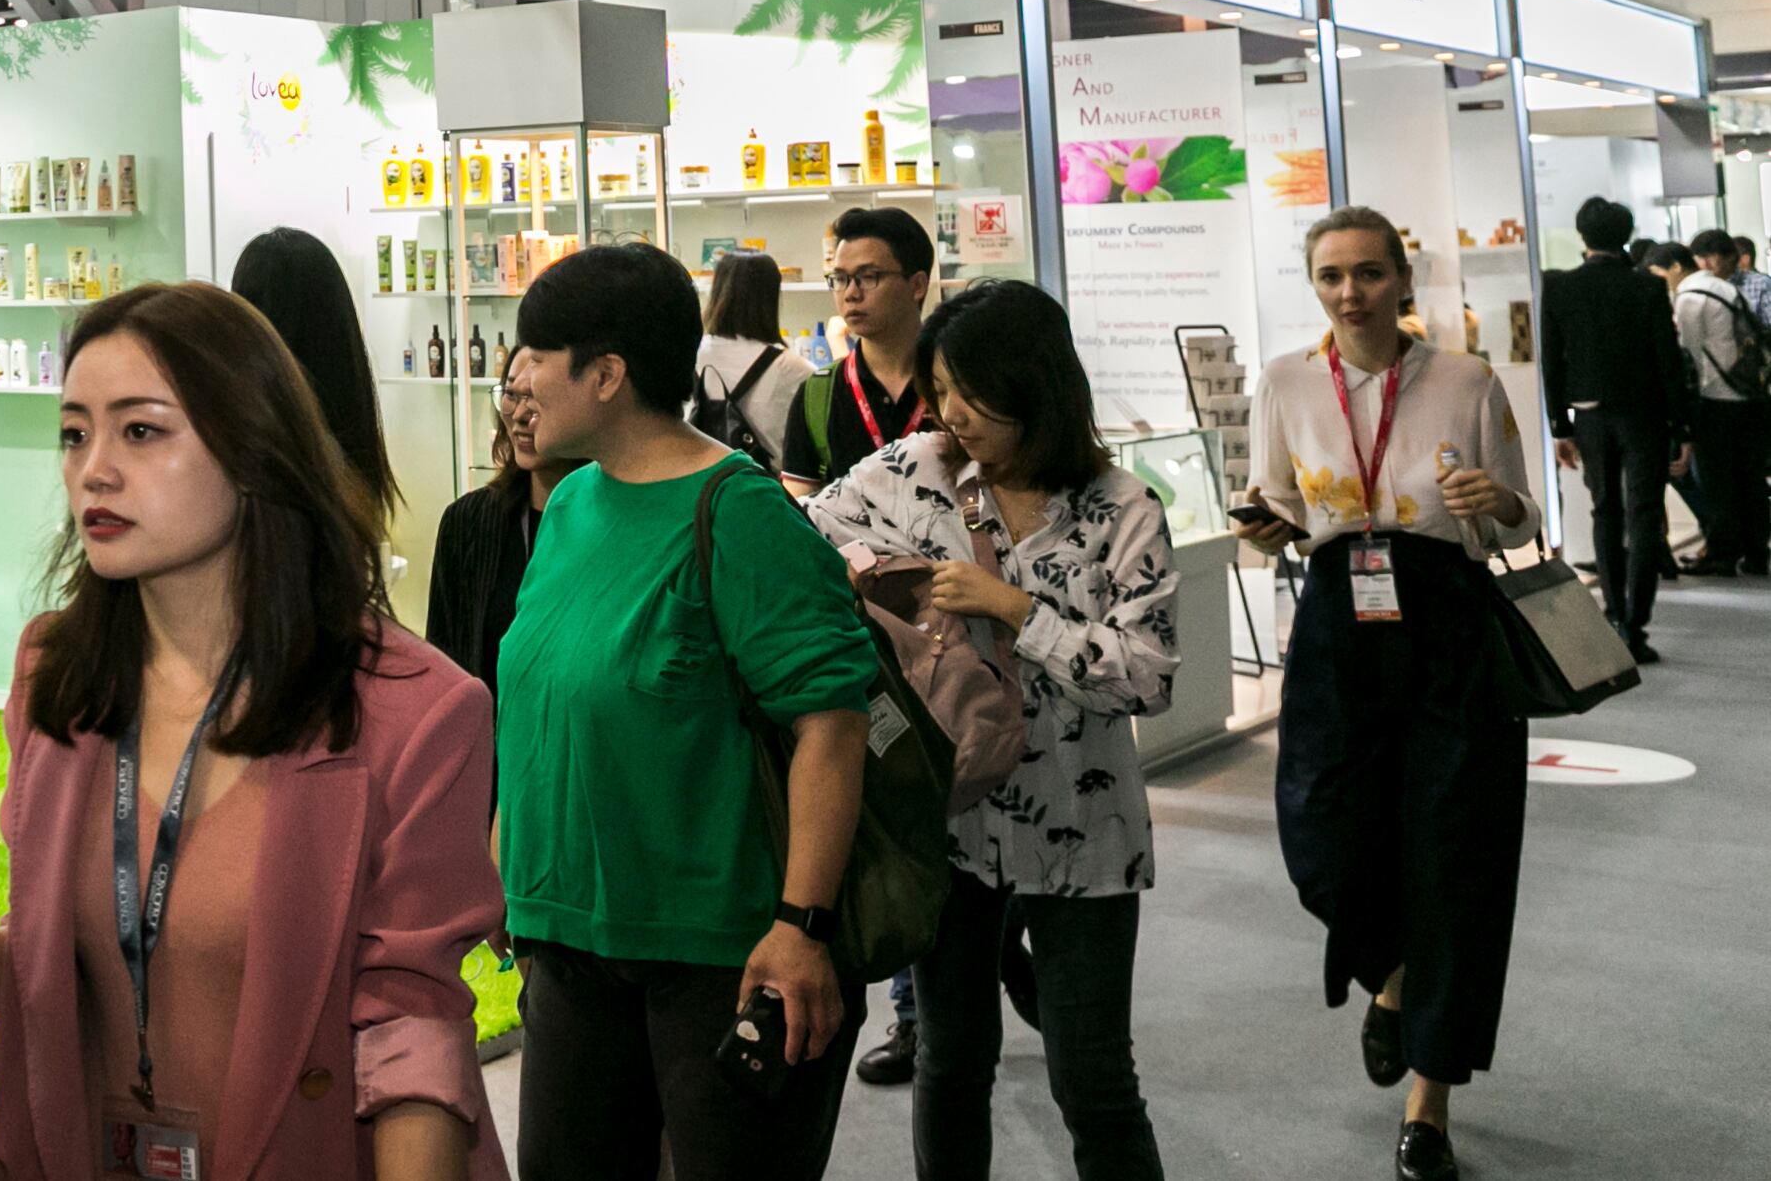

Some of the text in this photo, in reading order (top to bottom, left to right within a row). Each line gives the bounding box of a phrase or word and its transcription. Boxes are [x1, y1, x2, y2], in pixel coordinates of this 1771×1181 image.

[973, 23, 1001, 35] FRANCE
[251, 71, 300, 101] lovea
[1064, 226, 1123, 238] ERFUMERY
